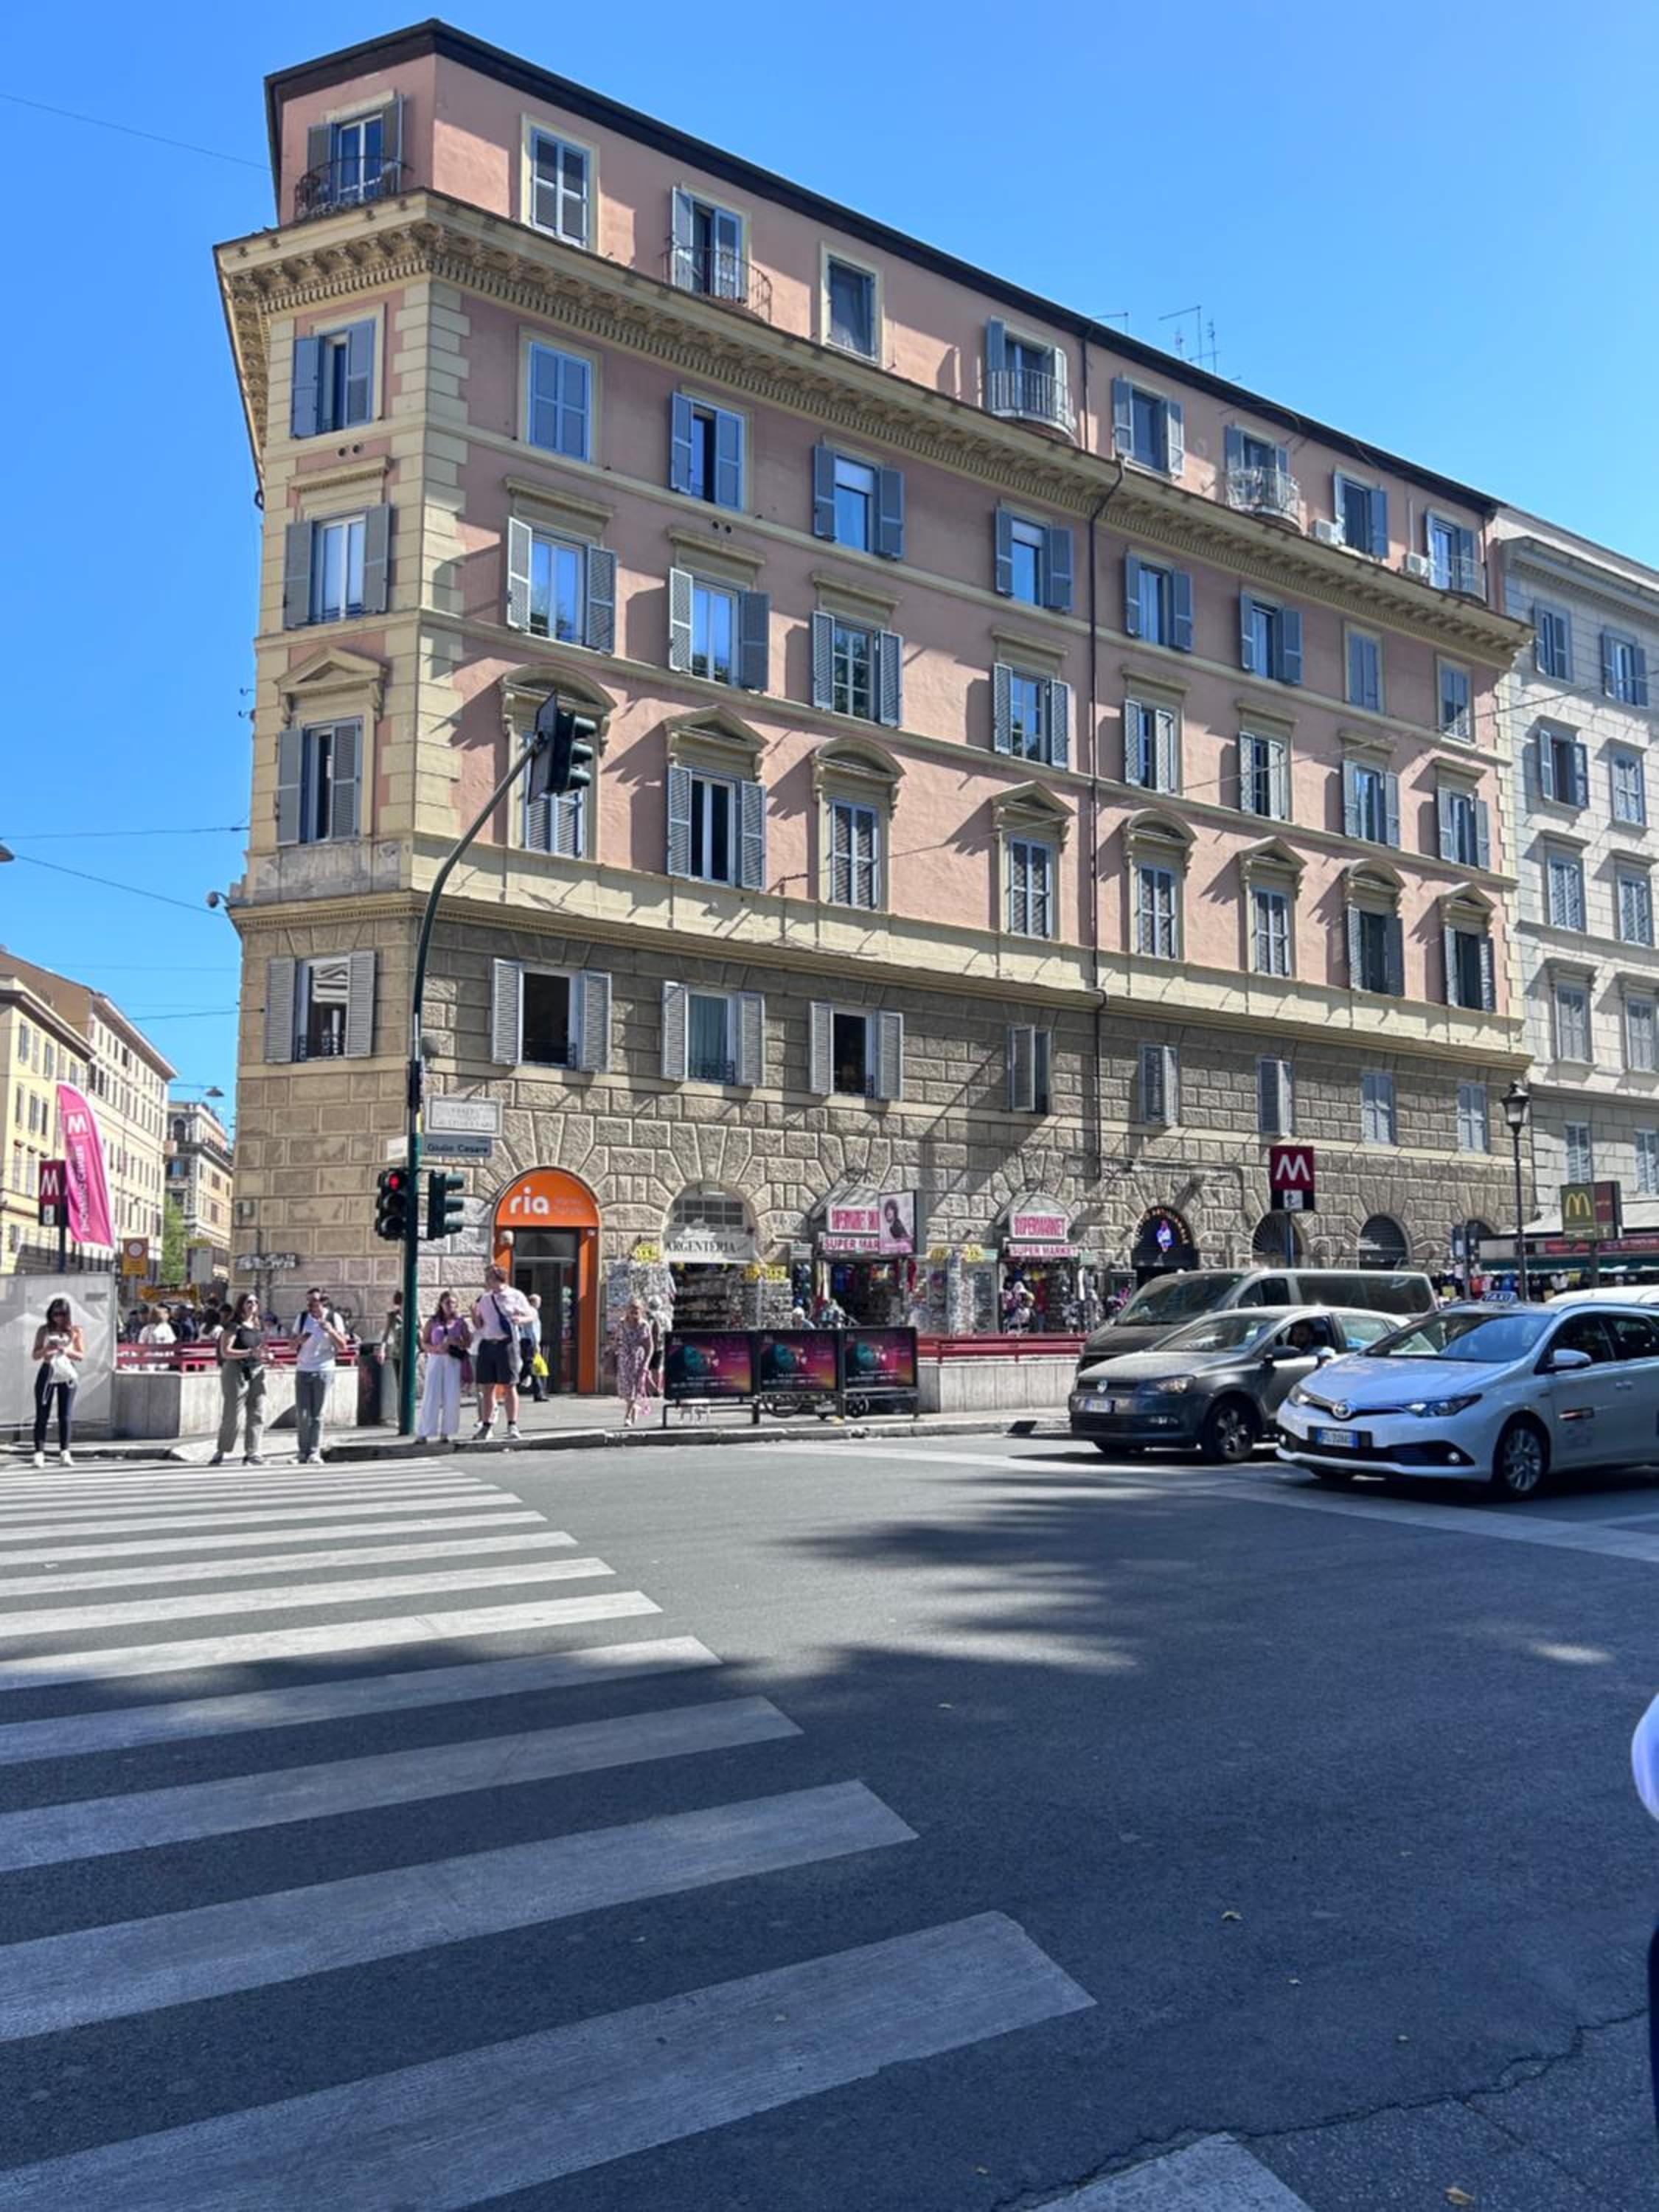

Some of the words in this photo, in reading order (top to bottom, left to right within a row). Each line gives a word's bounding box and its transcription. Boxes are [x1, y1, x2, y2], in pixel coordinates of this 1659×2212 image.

[68, 1115, 87, 1134] M
[458, 1144, 488, 1153] Cesare
[1276, 1154, 1310, 1181] M
[41, 1169, 60, 1196] M
[509, 1186, 549, 1215] ria
[665, 1240, 736, 1253] ARGENTERIA
[825, 1239, 855, 1250] SUPER
[859, 1239, 880, 1251] MAR
[1012, 1245, 1040, 1256] SUPER
[1485, 1293, 1512, 1303] TAXI
